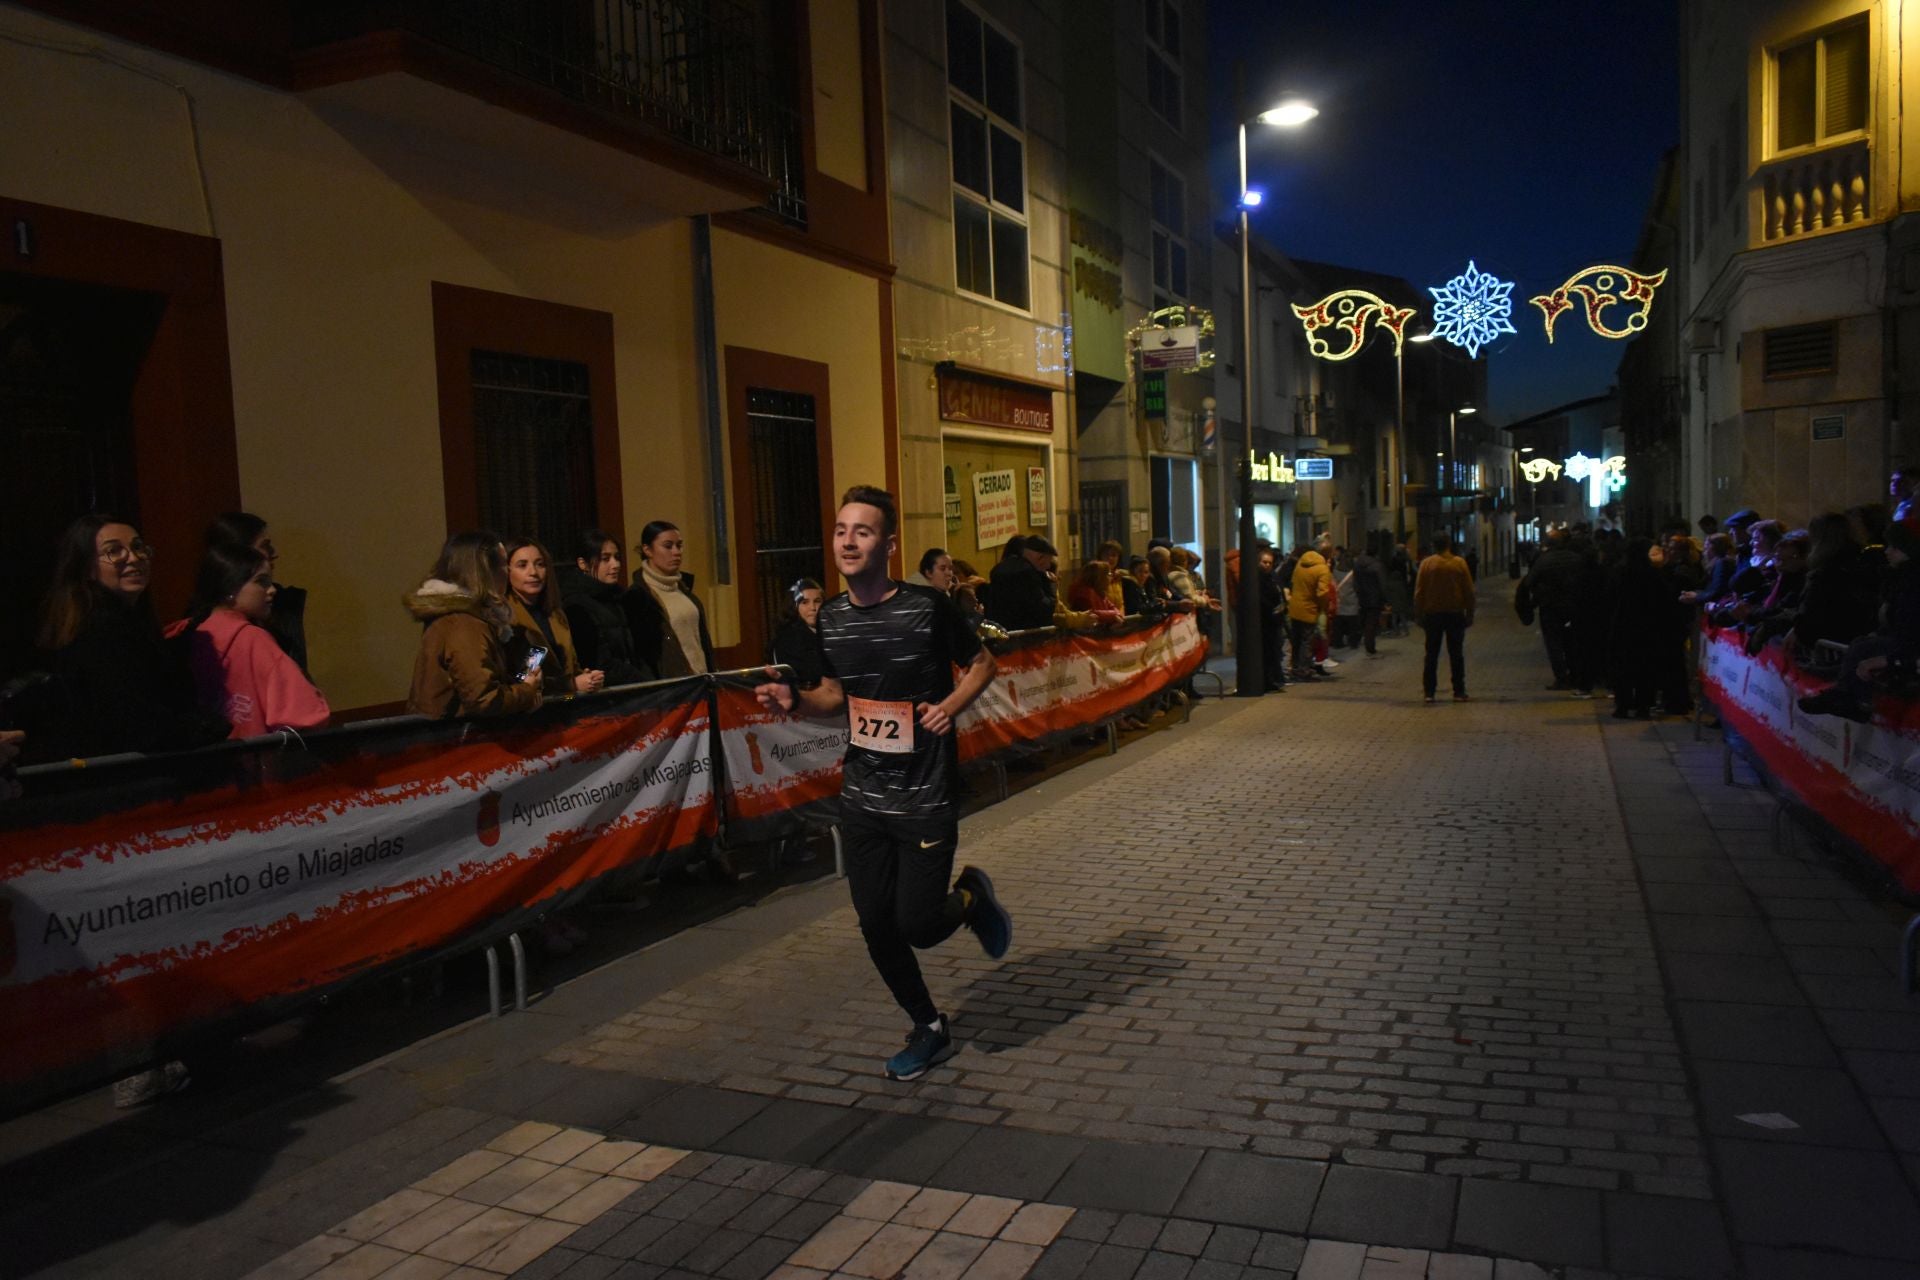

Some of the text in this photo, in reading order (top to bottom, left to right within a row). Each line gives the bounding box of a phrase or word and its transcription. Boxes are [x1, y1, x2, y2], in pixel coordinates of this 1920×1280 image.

[16, 220, 30, 254] 1
[1013, 408, 1050, 428] BOUTIQUE
[979, 474, 1011, 495] CERRADO
[858, 716, 899, 739] 272
[770, 734, 840, 761] Ayuntamiento
[512, 779, 624, 826] Ayuntamiento
[643, 755, 713, 787] Miajadas
[44, 835, 405, 946] Ayuntamiento de Miajadas
